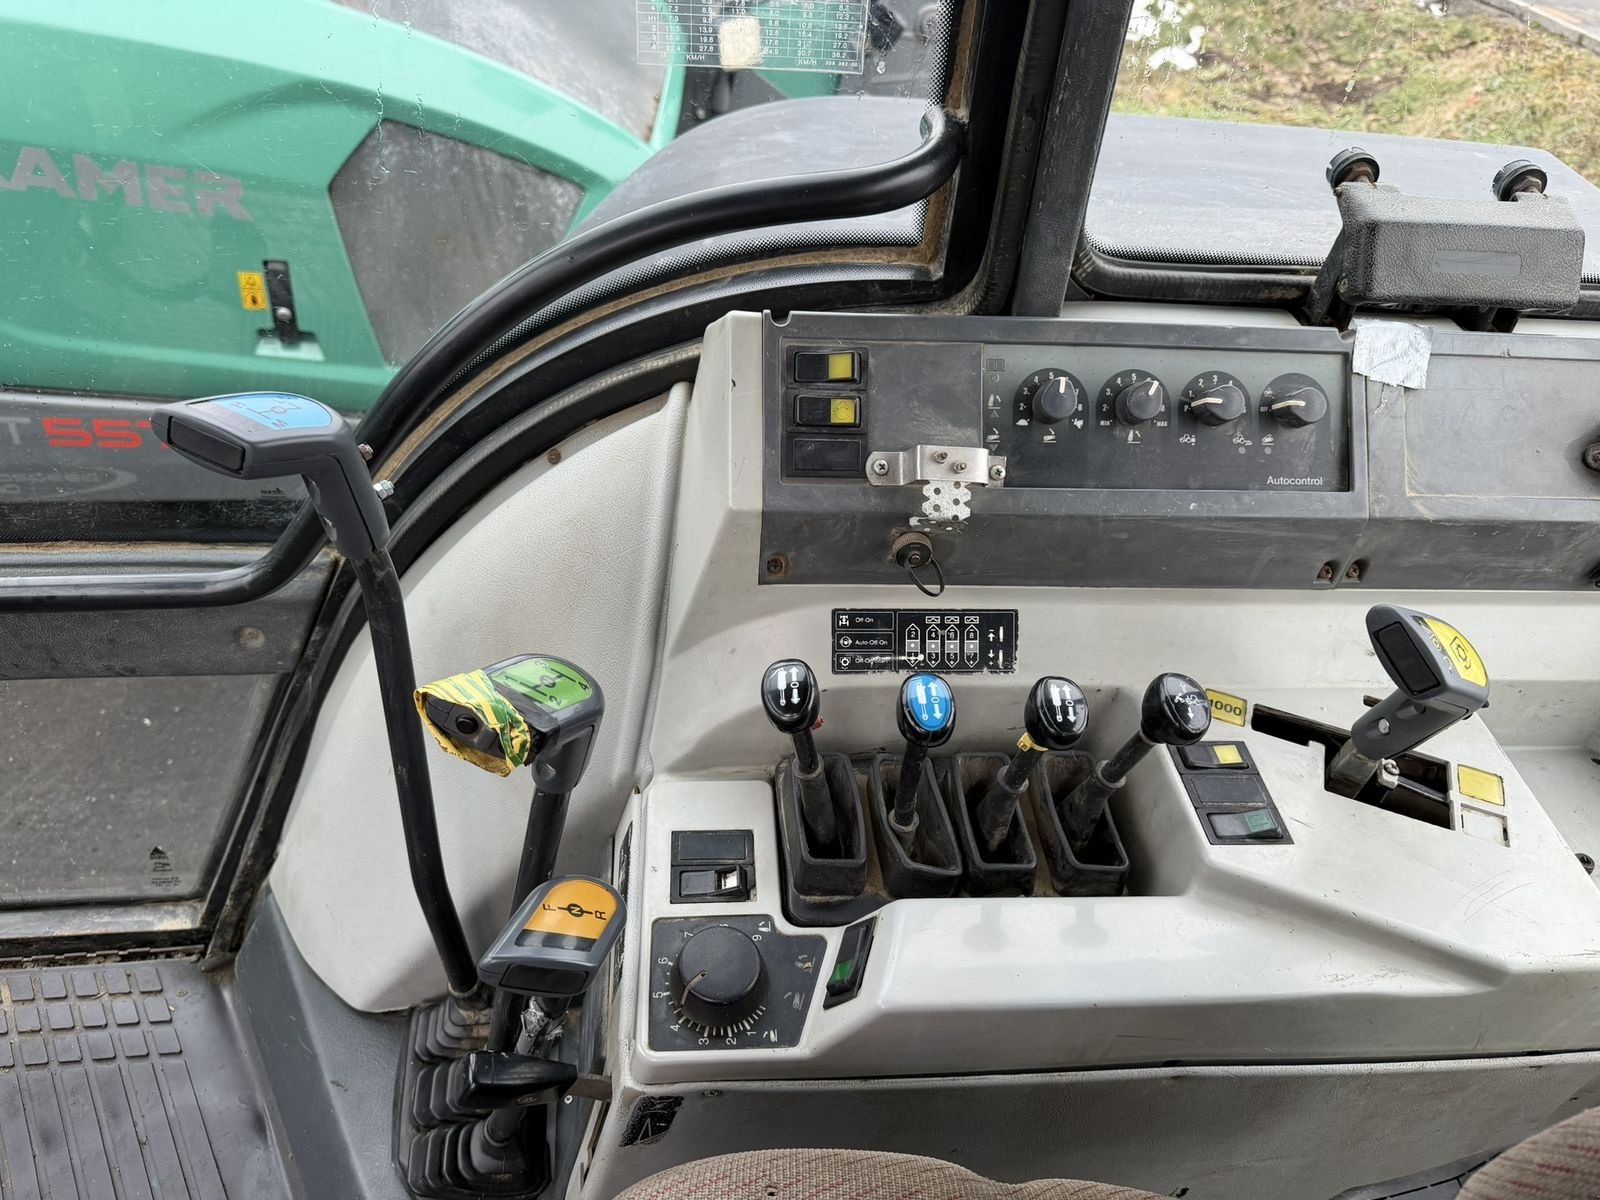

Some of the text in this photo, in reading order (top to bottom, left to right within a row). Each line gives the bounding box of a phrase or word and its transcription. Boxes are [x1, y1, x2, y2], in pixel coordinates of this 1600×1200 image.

[1049, 371, 1054, 379] 5
[1212, 374, 1218, 382] 3
[1198, 378, 1204, 386] 2
[1023, 387, 1028, 395] 3
[1105, 388, 1111, 396] 3
[1019, 403, 1025, 411] 2
[1102, 404, 1107, 412] 2
[1267, 475, 1323, 486] Autocontrol
[578, 681, 590, 691] 4
[549, 695, 562, 706] 2
[1209, 699, 1242, 716] 1000
[542, 903, 607, 921] F N R
[684, 931, 694, 939] 7
[652, 991, 664, 999] 5
[670, 1024, 681, 1032] 4
[698, 1037, 710, 1046] 3
[726, 1036, 737, 1045] 2
